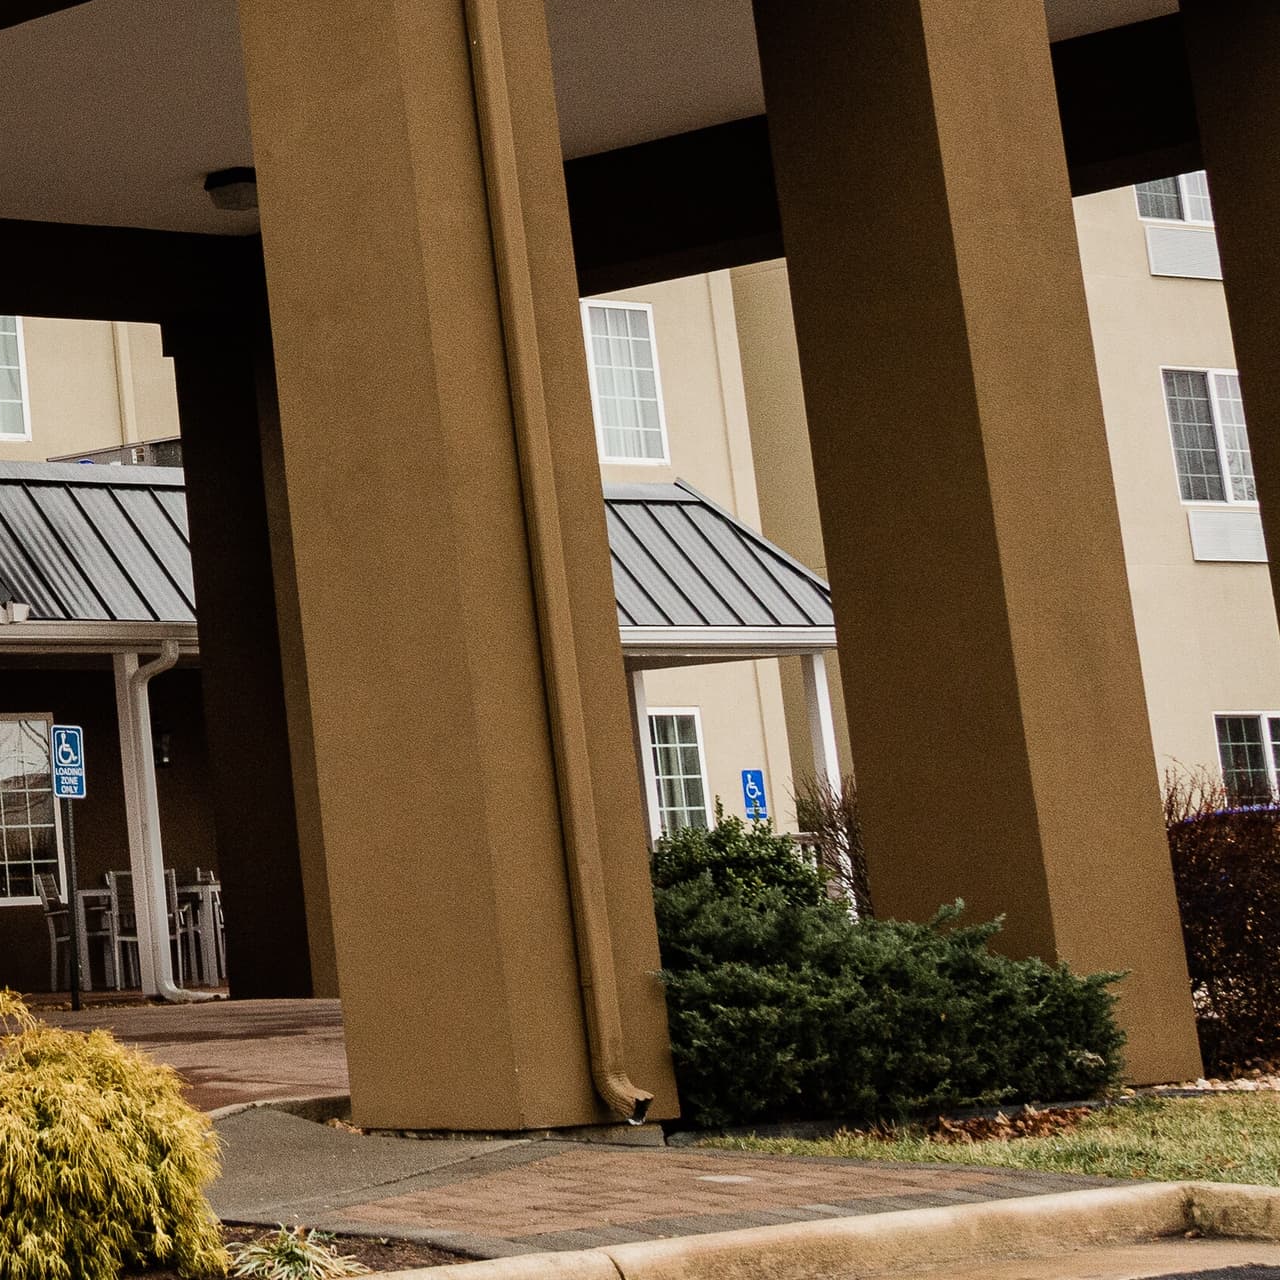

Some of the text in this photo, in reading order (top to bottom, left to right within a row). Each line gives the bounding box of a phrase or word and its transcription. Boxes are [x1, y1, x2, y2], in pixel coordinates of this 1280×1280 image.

[55, 768, 83, 776] LOADING
[61, 776, 78, 785] ZONE
[61, 785, 78, 793] ONLY
